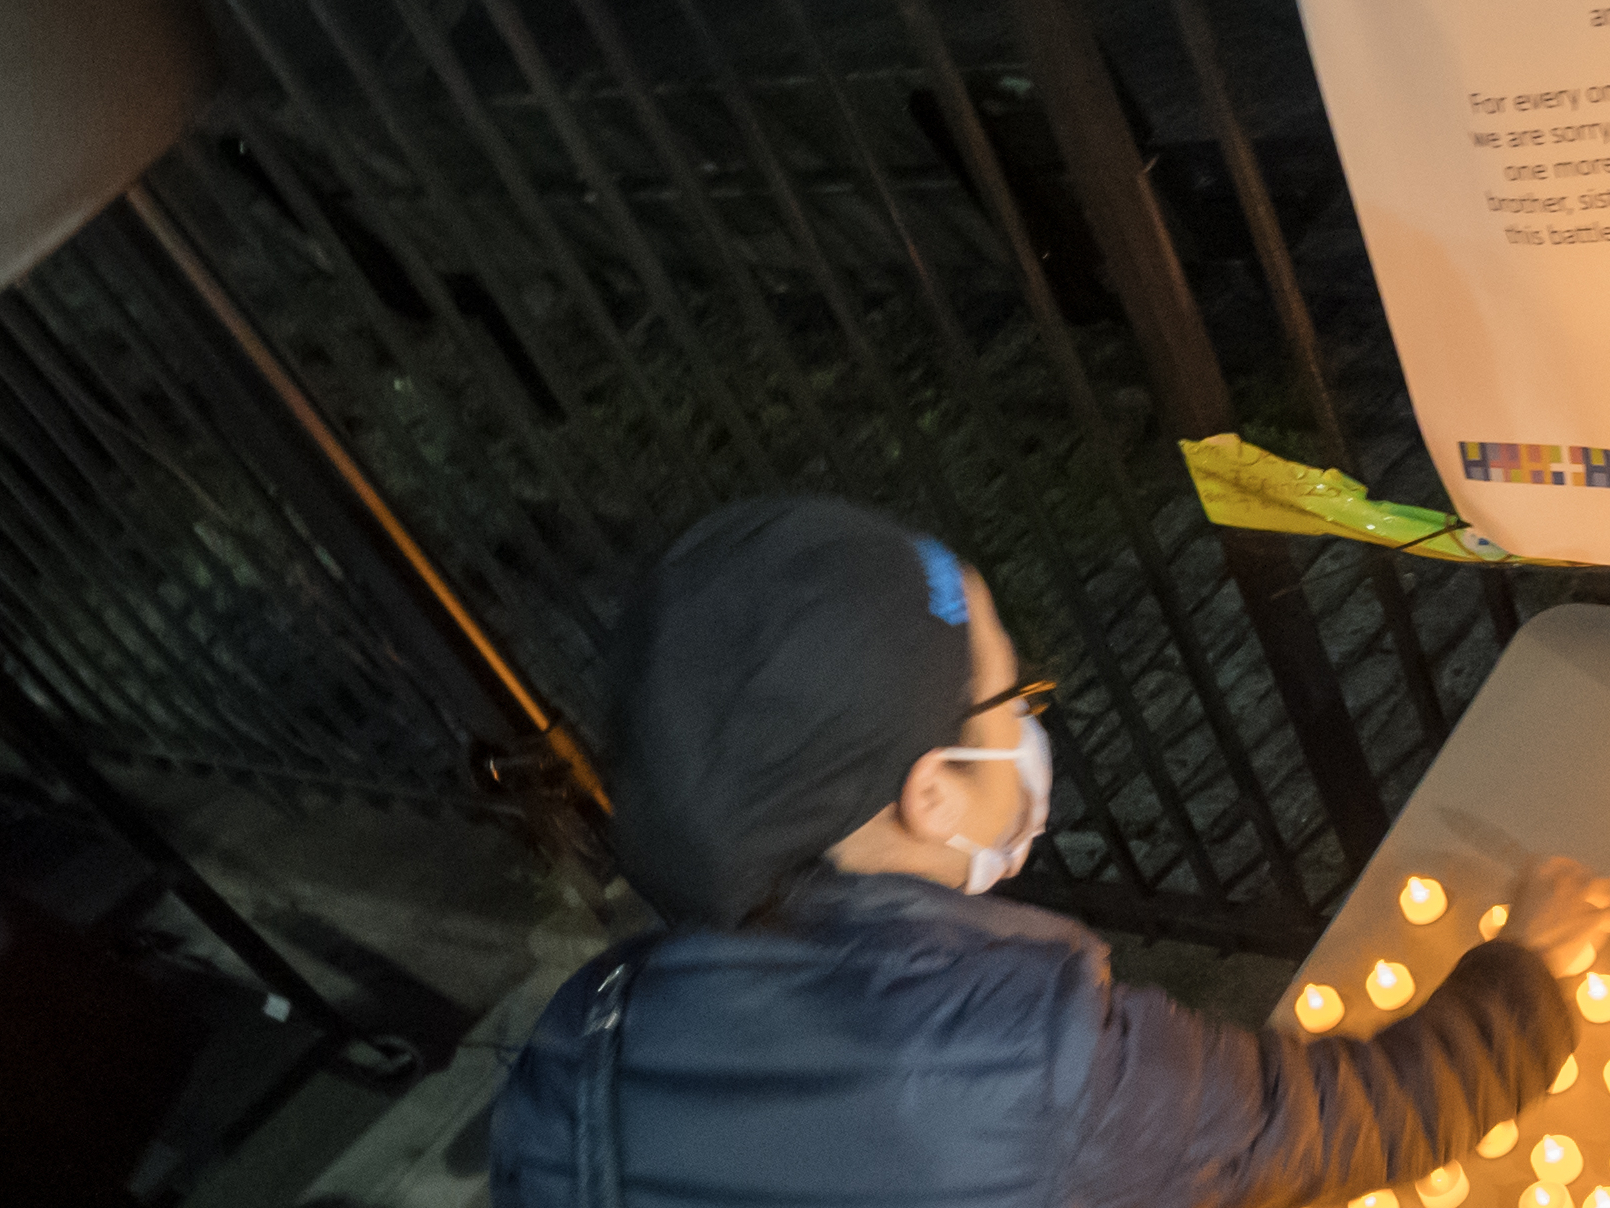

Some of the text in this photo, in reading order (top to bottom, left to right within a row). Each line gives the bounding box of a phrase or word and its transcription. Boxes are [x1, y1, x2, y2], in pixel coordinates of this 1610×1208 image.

[1468, 93, 1506, 114] For
[1513, 88, 1581, 111] every
[1468, 130, 1500, 149] we
[1506, 129, 1545, 148] are
[1503, 164, 1548, 182] one
[1484, 190, 1574, 216] brother,
[1504, 222, 1545, 246] this
